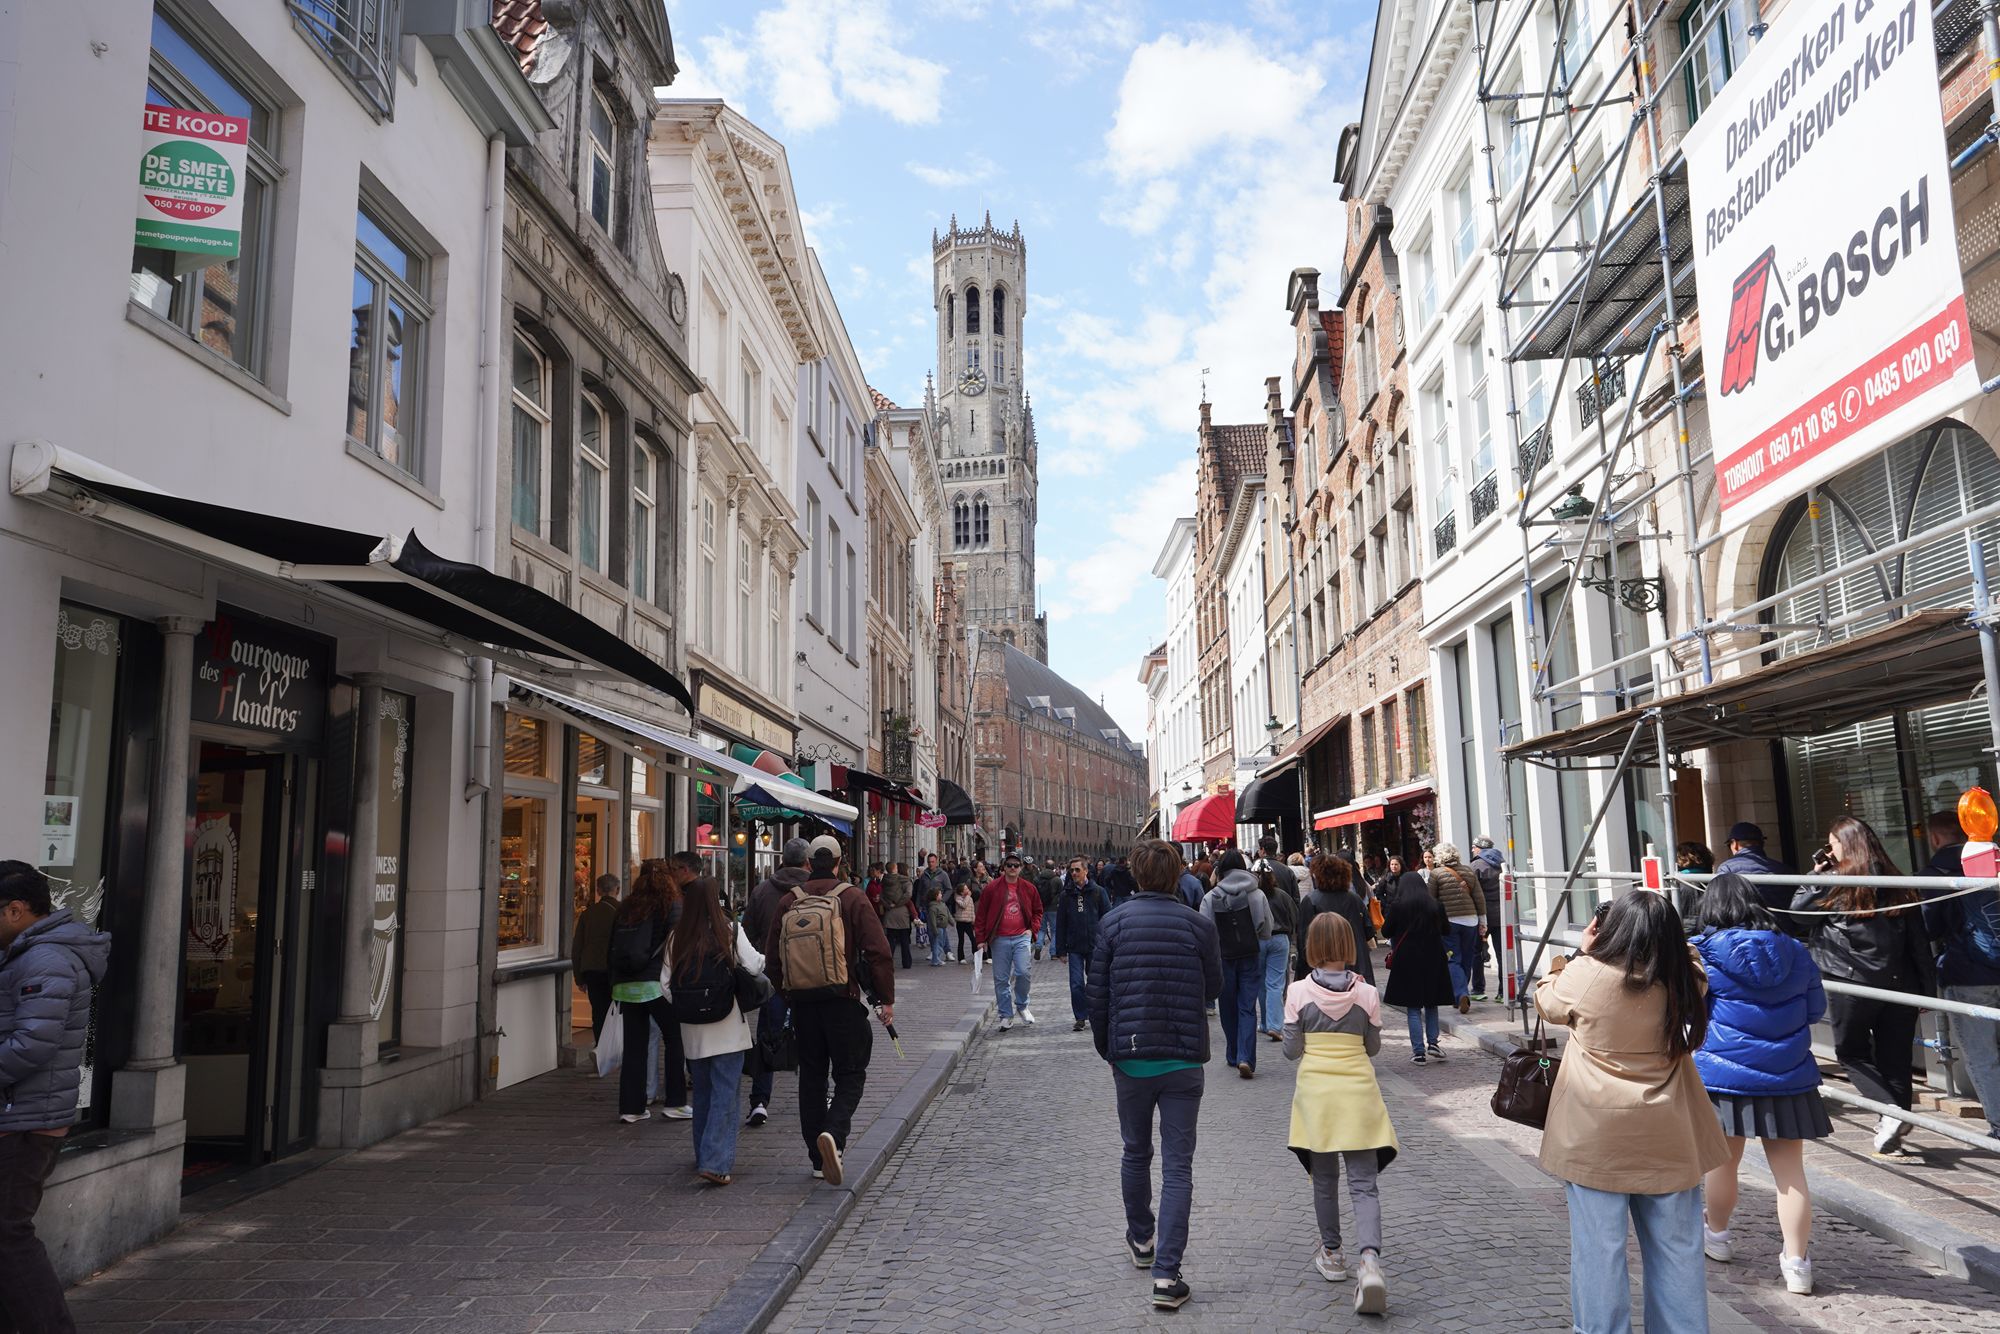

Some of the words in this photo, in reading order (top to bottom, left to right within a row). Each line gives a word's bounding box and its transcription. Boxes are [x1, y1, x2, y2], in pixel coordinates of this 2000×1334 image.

[1726, 2, 1845, 174] Dakwerken
[145, 110, 171, 128] TE
[176, 115, 238, 137] KOOP
[1706, 0, 1916, 257] Restauratiewerken
[146, 154, 171, 171] DE
[178, 159, 230, 179] SMET
[145, 169, 228, 193] POUPEYE
[154, 199, 173, 209] 050
[189, 204, 201, 212] 00
[203, 206, 216, 214] 00
[1724, 447, 1765, 493] TORHOUT
[1769, 433, 1790, 466] 050
[1791, 422, 1806, 449] 21
[1805, 414, 1820, 442] 10
[1821, 402, 1838, 434] 85
[1864, 361, 1900, 406] 0485
[1902, 342, 1932, 383] 020
[207, 614, 311, 699] Bourgogne
[200, 661, 219, 682] des
[375, 883, 396, 902] RNER
